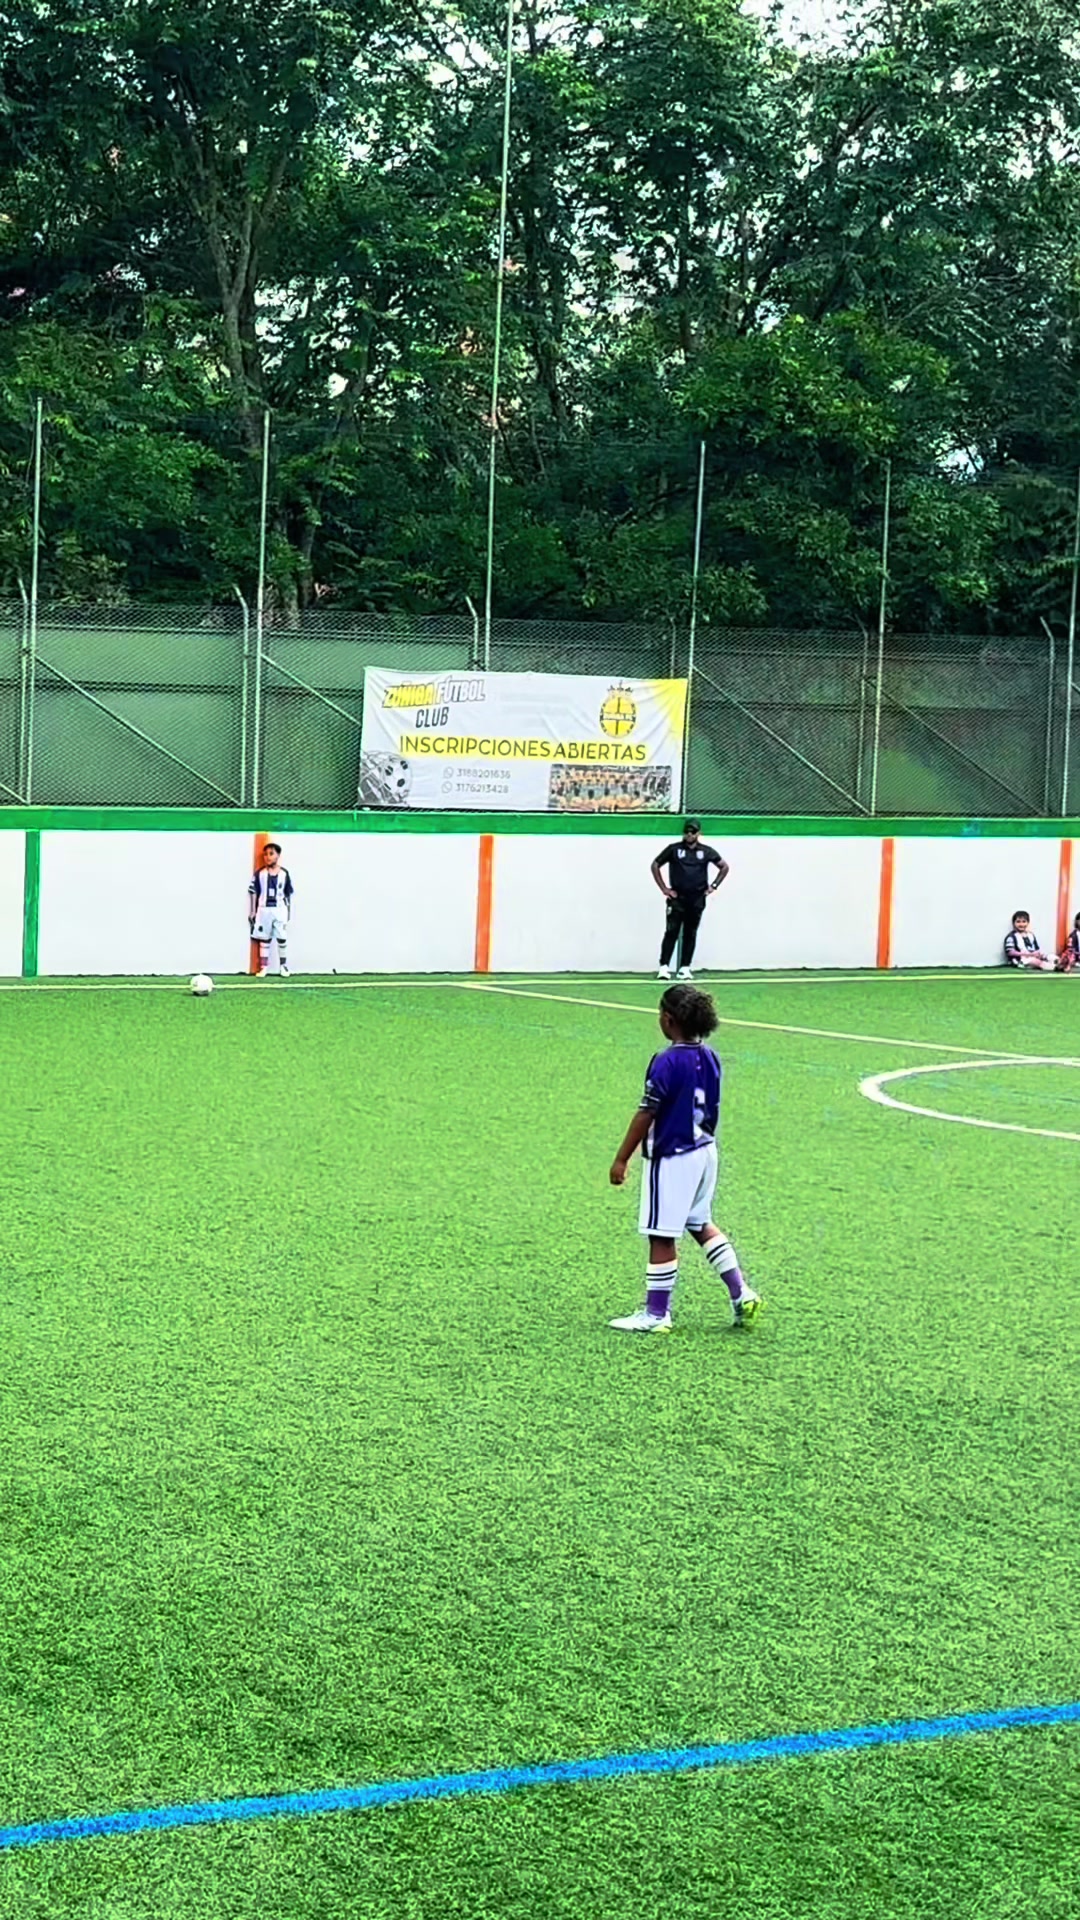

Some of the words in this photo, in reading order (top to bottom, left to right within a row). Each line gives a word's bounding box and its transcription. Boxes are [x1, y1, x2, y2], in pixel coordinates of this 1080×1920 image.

[436, 675, 485, 704] FÚTBOL
[415, 706, 449, 728] CLUB
[400, 736, 550, 757] INSCRIPCIONES
[554, 743, 646, 761] ABIERTAS
